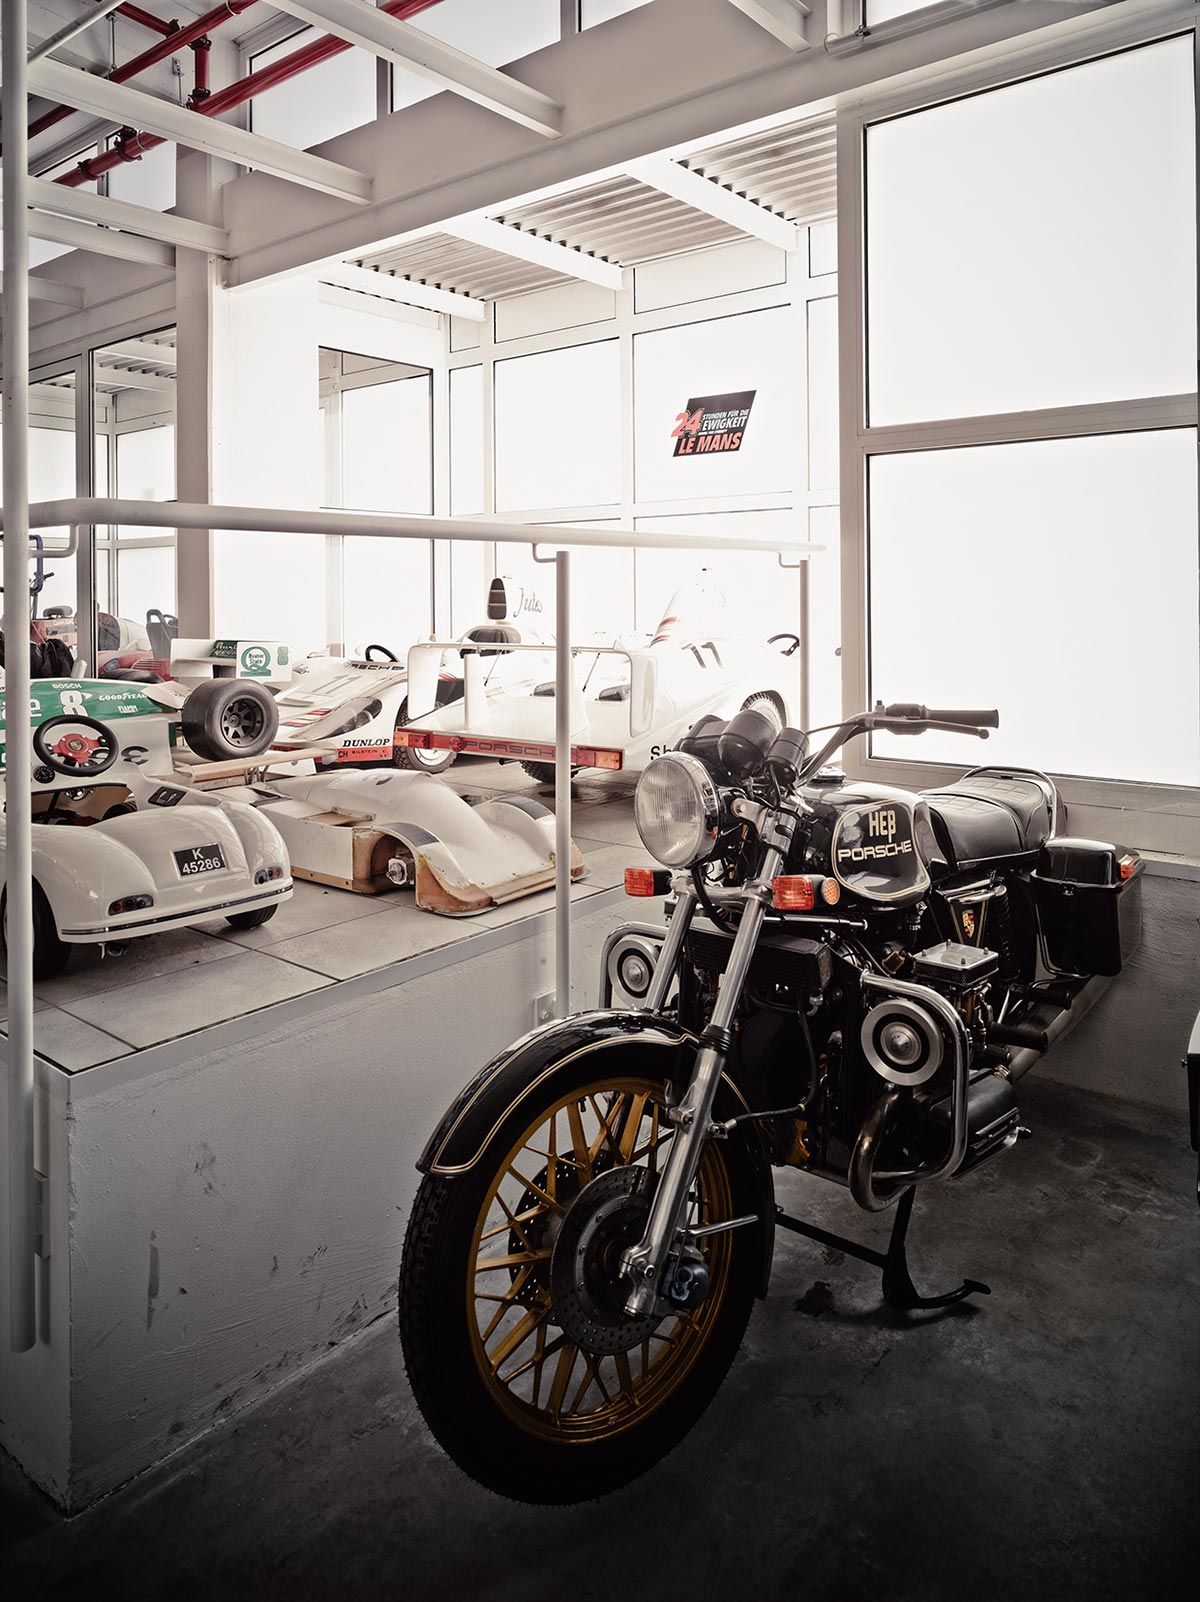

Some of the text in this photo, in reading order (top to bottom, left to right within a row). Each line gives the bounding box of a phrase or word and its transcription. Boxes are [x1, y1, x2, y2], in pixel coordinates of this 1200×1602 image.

[671, 408, 704, 438] 24
[703, 411, 727, 420] STUNDEN
[702, 416, 747, 431] EWIGKEIT
[678, 432, 742, 454] LE MANS
[513, 587, 543, 617] Jules
[60, 690, 89, 717] 8
[342, 738, 390, 748] DUNLOP
[464, 740, 556, 758] PORSCH
[192, 848, 204, 860] K
[837, 840, 912, 863] PORSCHE
[182, 857, 221, 874] 45286
